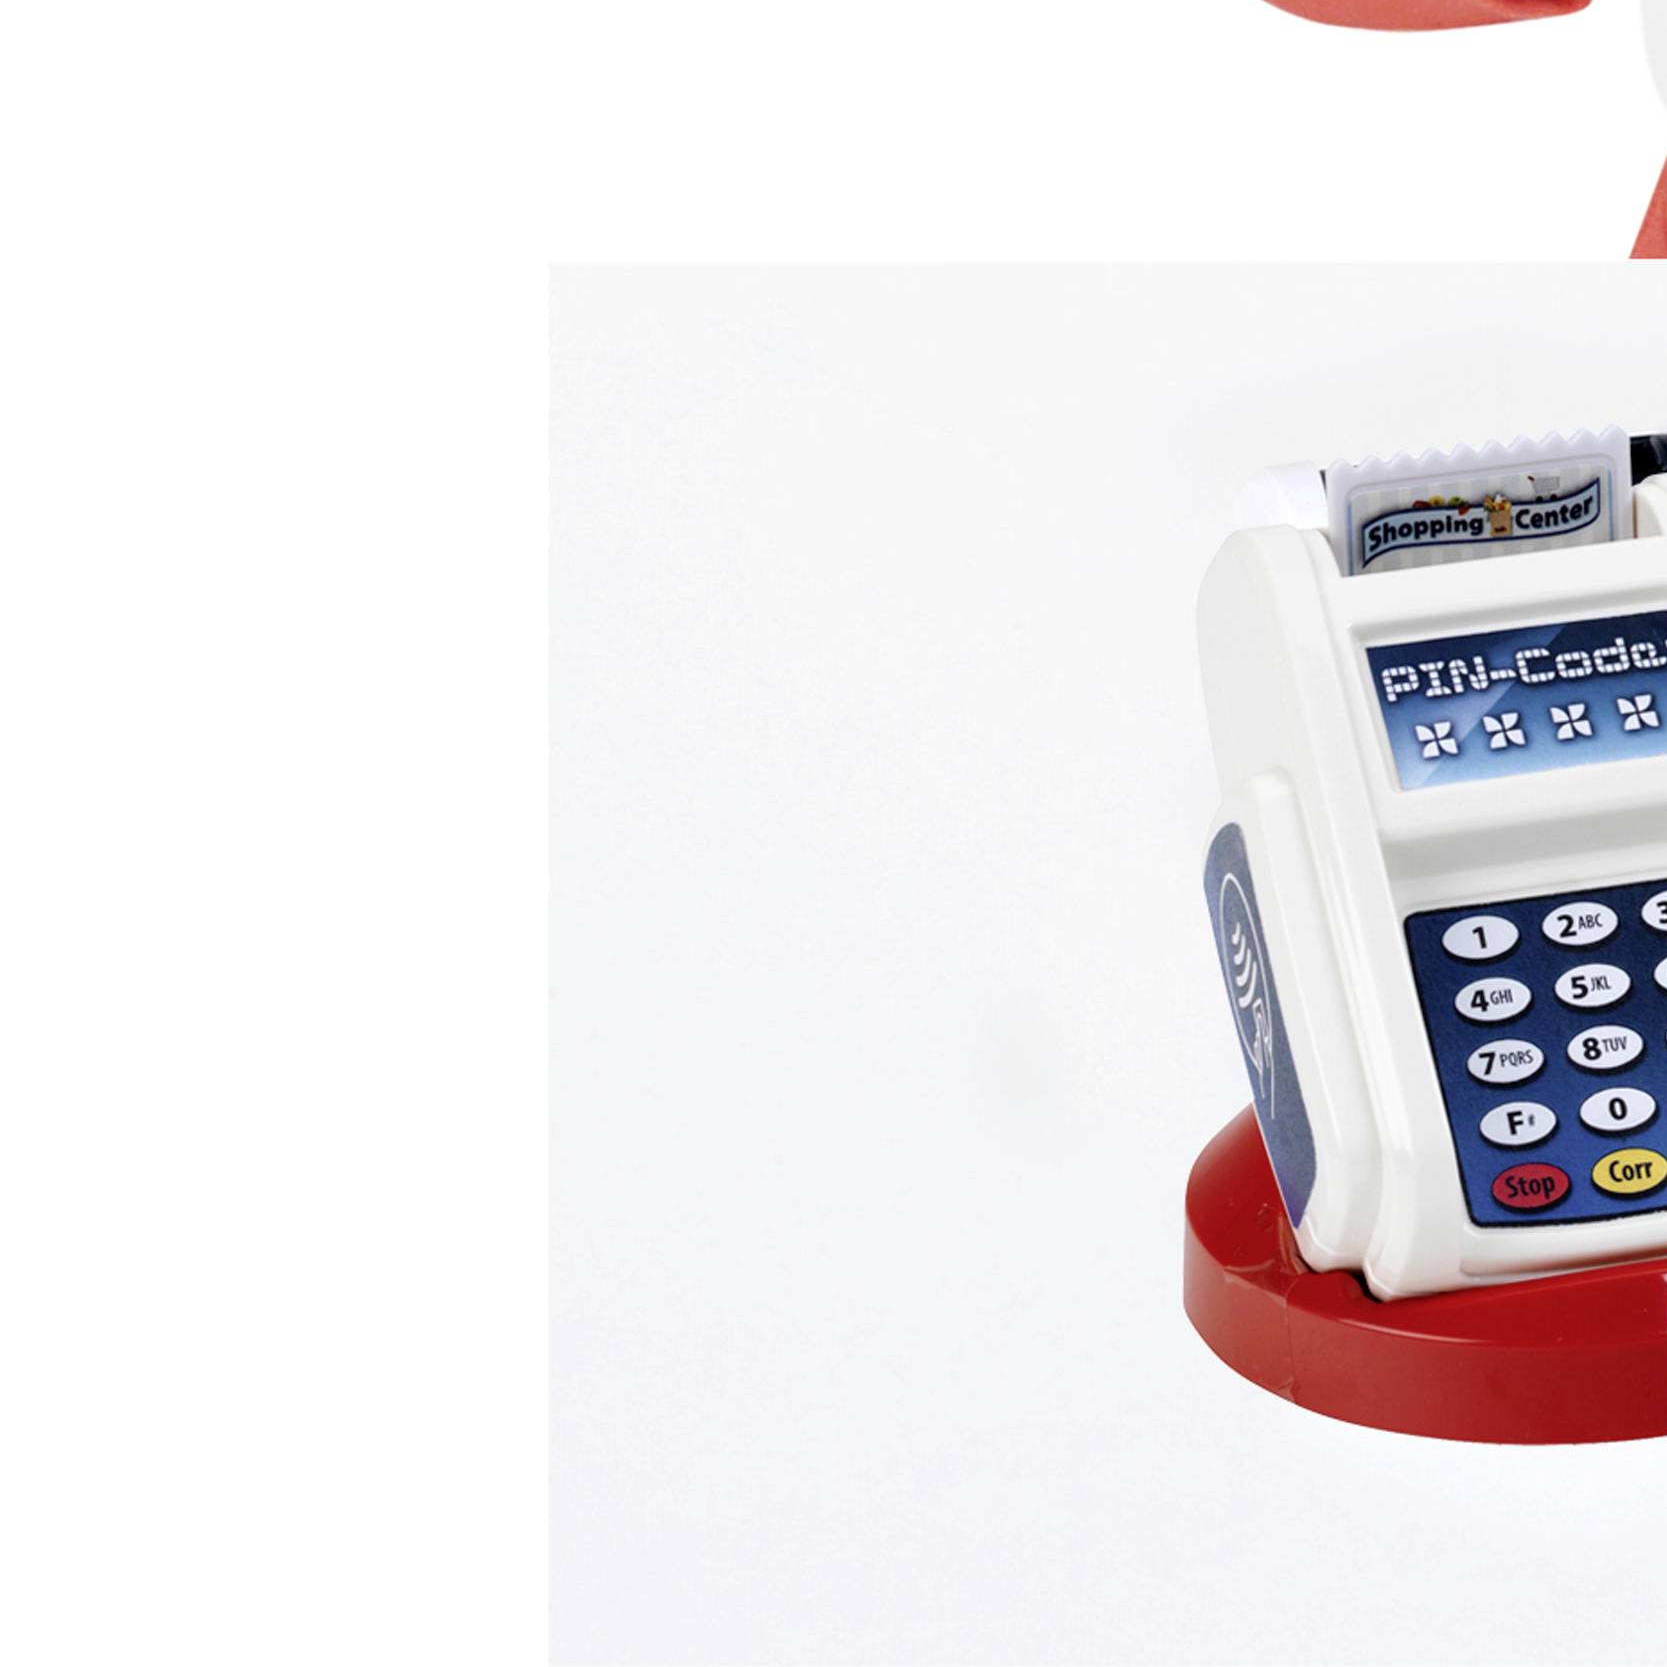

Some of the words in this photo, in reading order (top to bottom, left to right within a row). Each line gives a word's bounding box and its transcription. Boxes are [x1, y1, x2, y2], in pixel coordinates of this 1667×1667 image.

[1368, 515, 1484, 552] Shopping
[1515, 494, 1594, 530] Center
[1472, 927, 1488, 949] 1
[1609, 1097, 1627, 1120] 0
[1609, 1160, 1653, 1183] Corr
[1504, 1177, 1555, 1200] Stop
